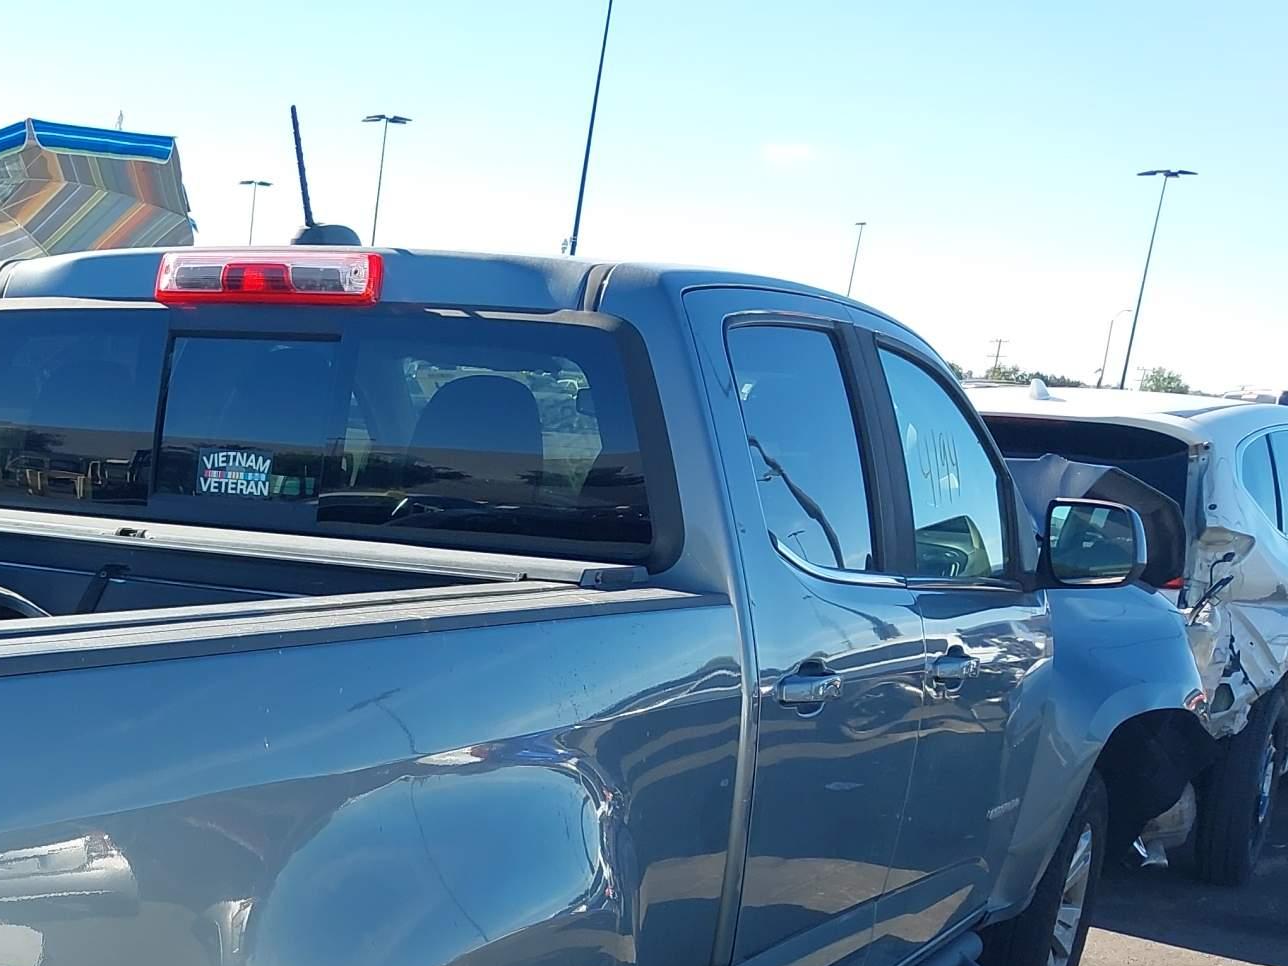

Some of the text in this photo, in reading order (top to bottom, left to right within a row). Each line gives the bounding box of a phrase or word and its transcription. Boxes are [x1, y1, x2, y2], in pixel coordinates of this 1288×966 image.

[203, 451, 271, 474] VIETNAM
[918, 428, 961, 508] 4194
[200, 477, 269, 496] VETERAN
